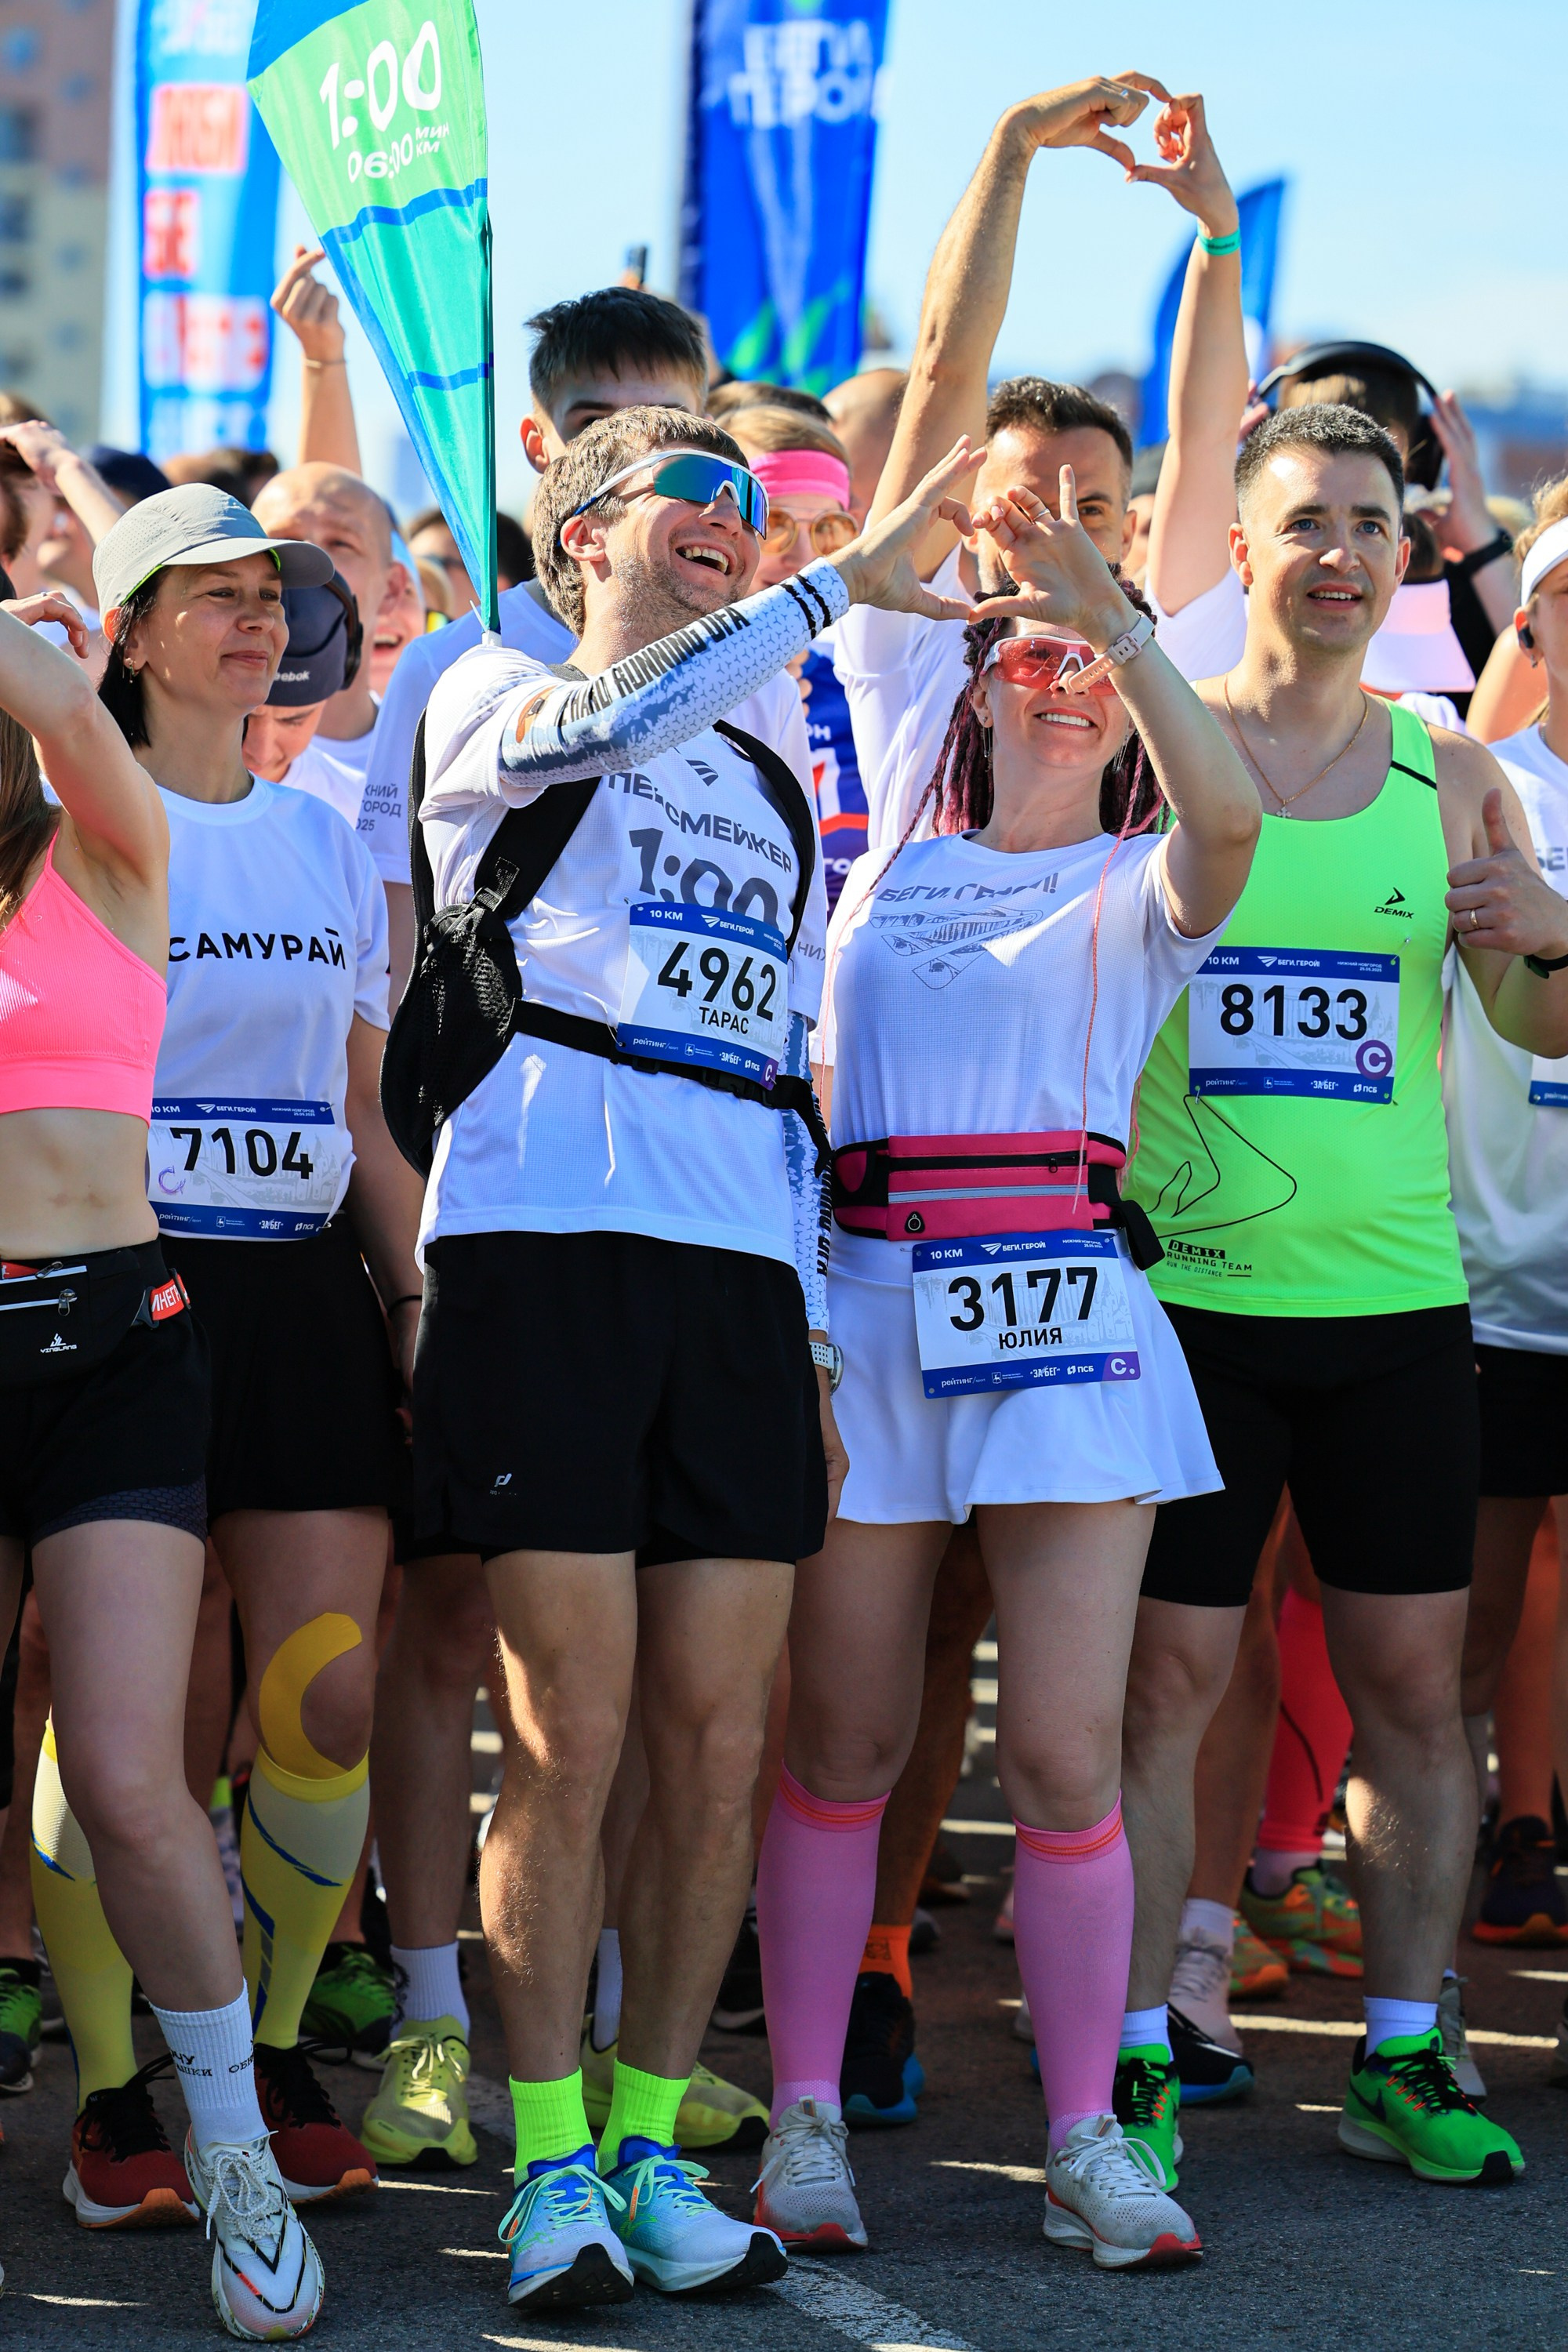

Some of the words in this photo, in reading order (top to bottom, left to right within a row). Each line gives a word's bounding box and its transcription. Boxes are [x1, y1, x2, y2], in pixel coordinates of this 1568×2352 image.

[319, 20, 441, 151] 1:00
[362, 800, 401, 818] ОРОД
[649, 909, 662, 918] 10
[1374, 906, 1414, 919] DEMIX
[169, 927, 347, 971] САМУРАЙ
[1207, 956, 1220, 965] 10
[657, 941, 776, 1022] 4962
[699, 1006, 750, 1035] ТАРАС
[1220, 983, 1367, 1041] 8133
[1363, 1085, 1377, 1094] ПСБ
[169, 1127, 314, 1180] 7104
[930, 1250, 942, 1260] 10
[1171, 1241, 1221, 1258] DEMIX
[1167, 1251, 1216, 1267] RUNNING
[1221, 1261, 1253, 1272] TEAM
[1167, 1260, 1178, 1269] RUN
[1181, 1263, 1192, 1272] THE
[1194, 1266, 1222, 1278] DISTANCE
[948, 1266, 1098, 1331] 3177
[998, 1327, 1063, 1350] ЮЛИЯ
[40, 1344, 77, 1353] YINGLANG
